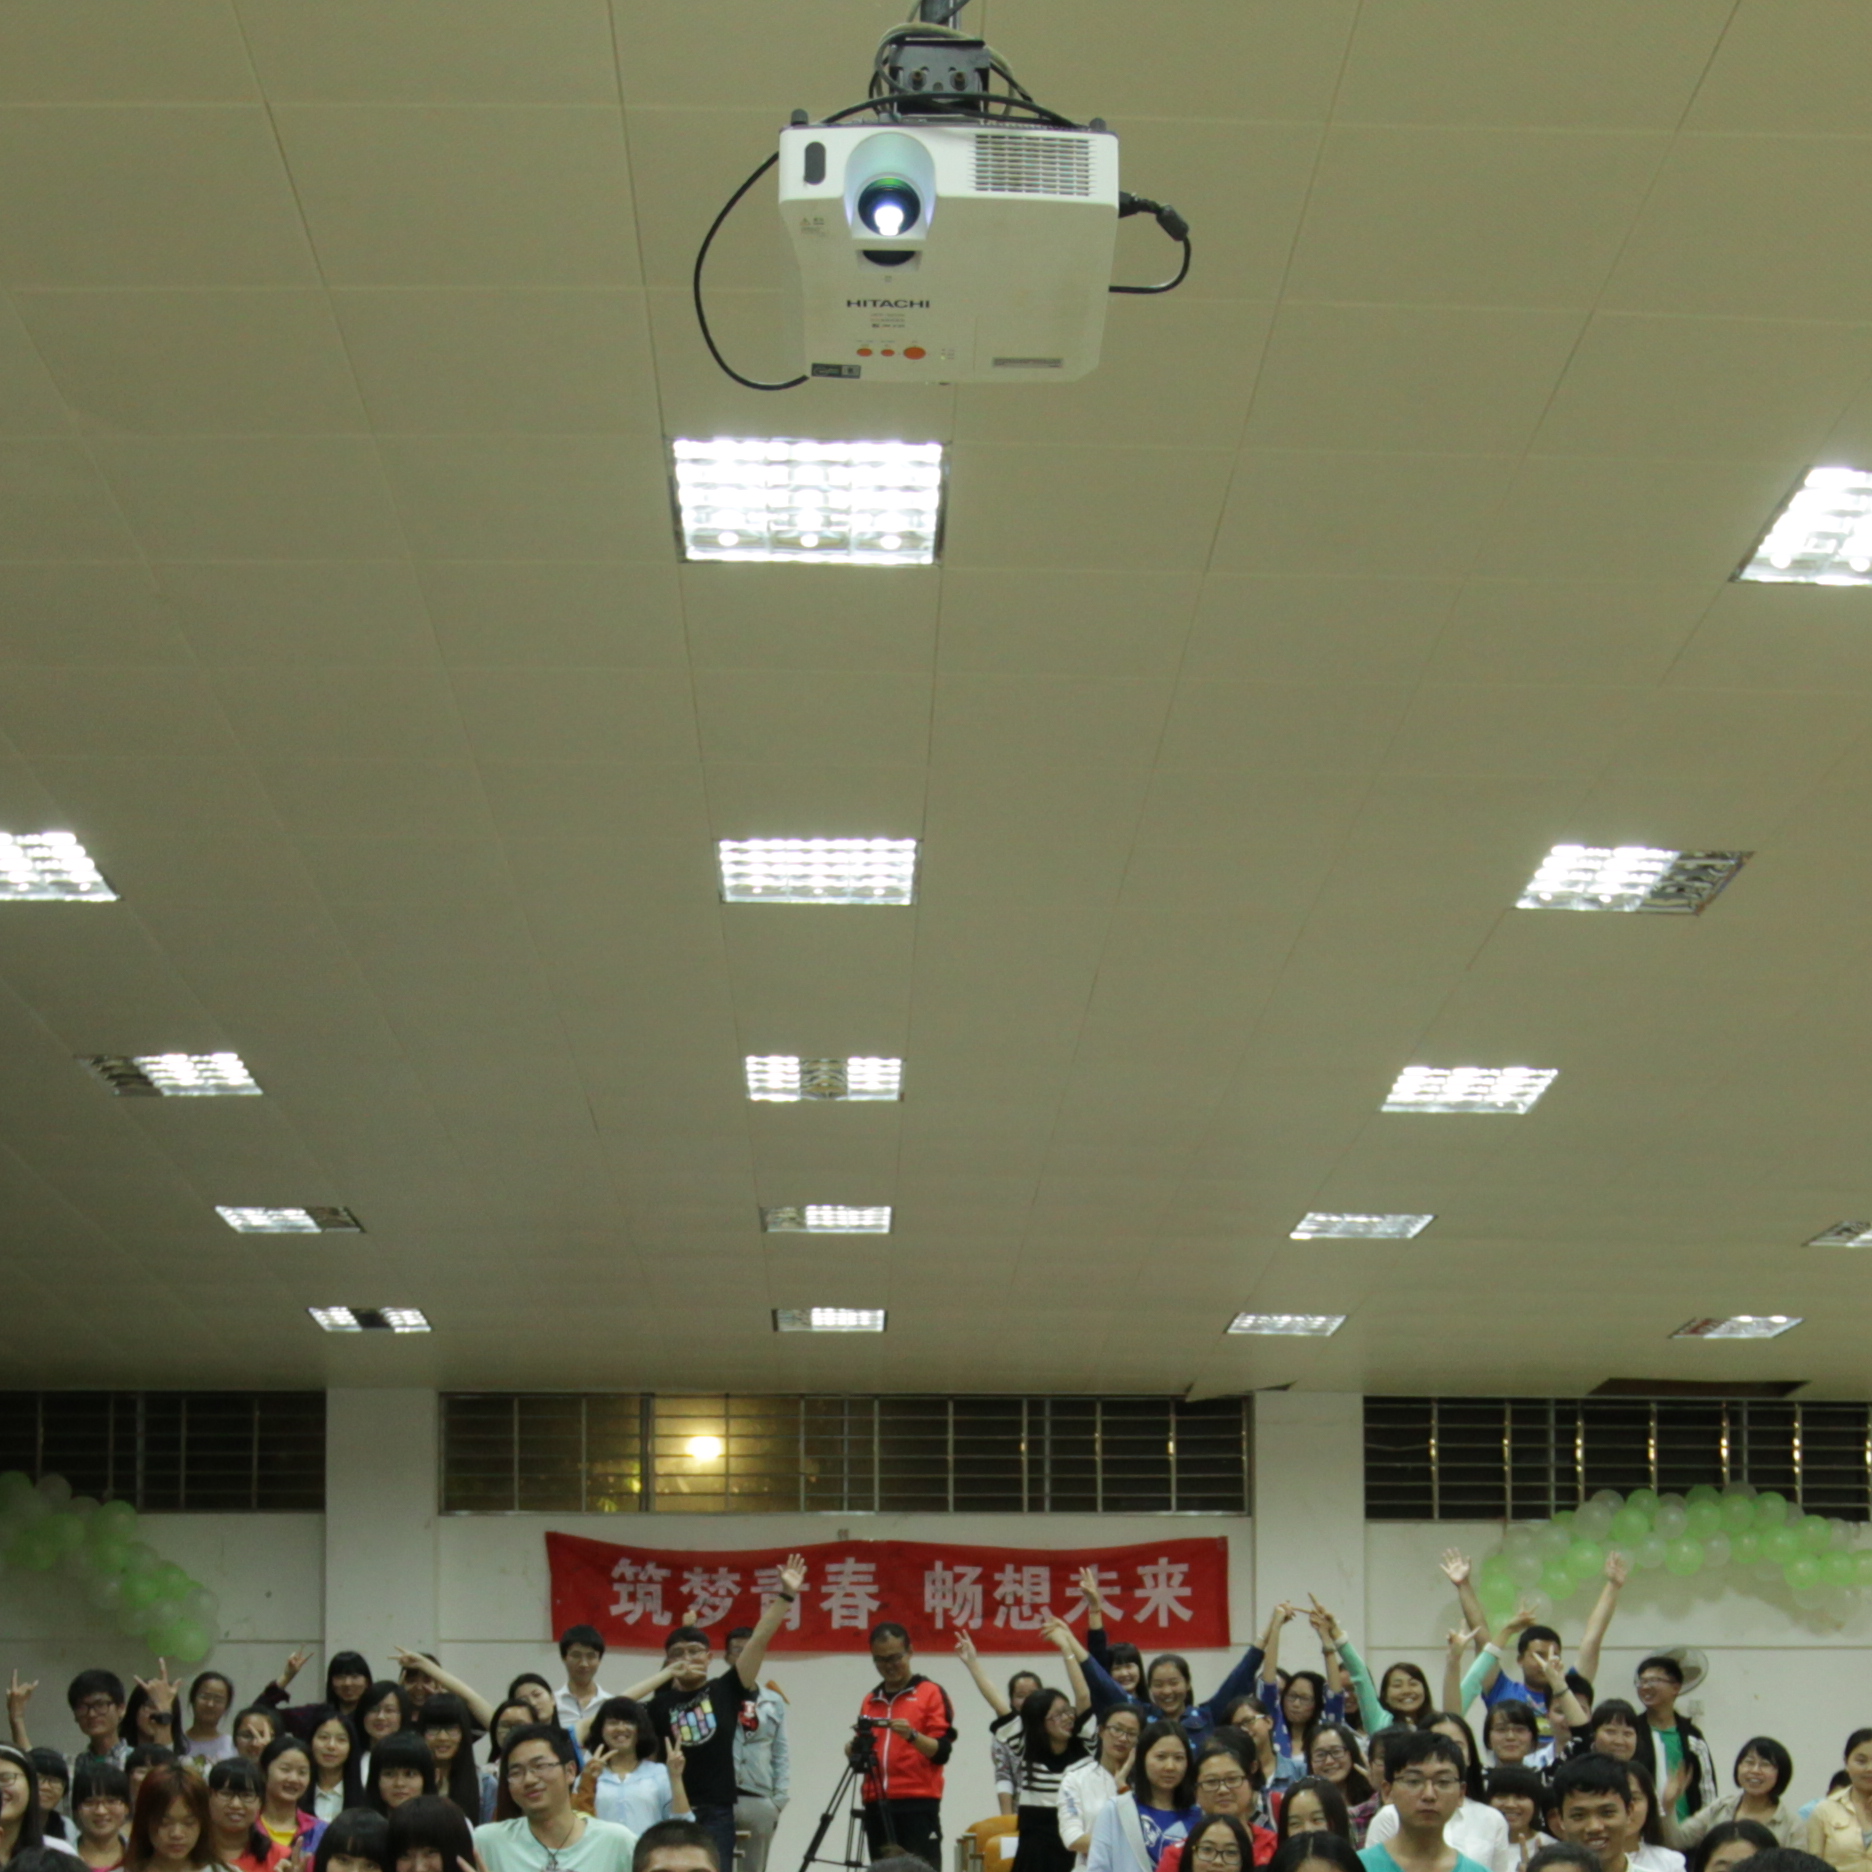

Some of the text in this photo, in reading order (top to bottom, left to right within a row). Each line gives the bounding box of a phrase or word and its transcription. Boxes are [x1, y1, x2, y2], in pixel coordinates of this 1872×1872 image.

[846, 299, 931, 309] HITACHI
[609, 1556, 1194, 1630] 筑梦青春 畅想未来
